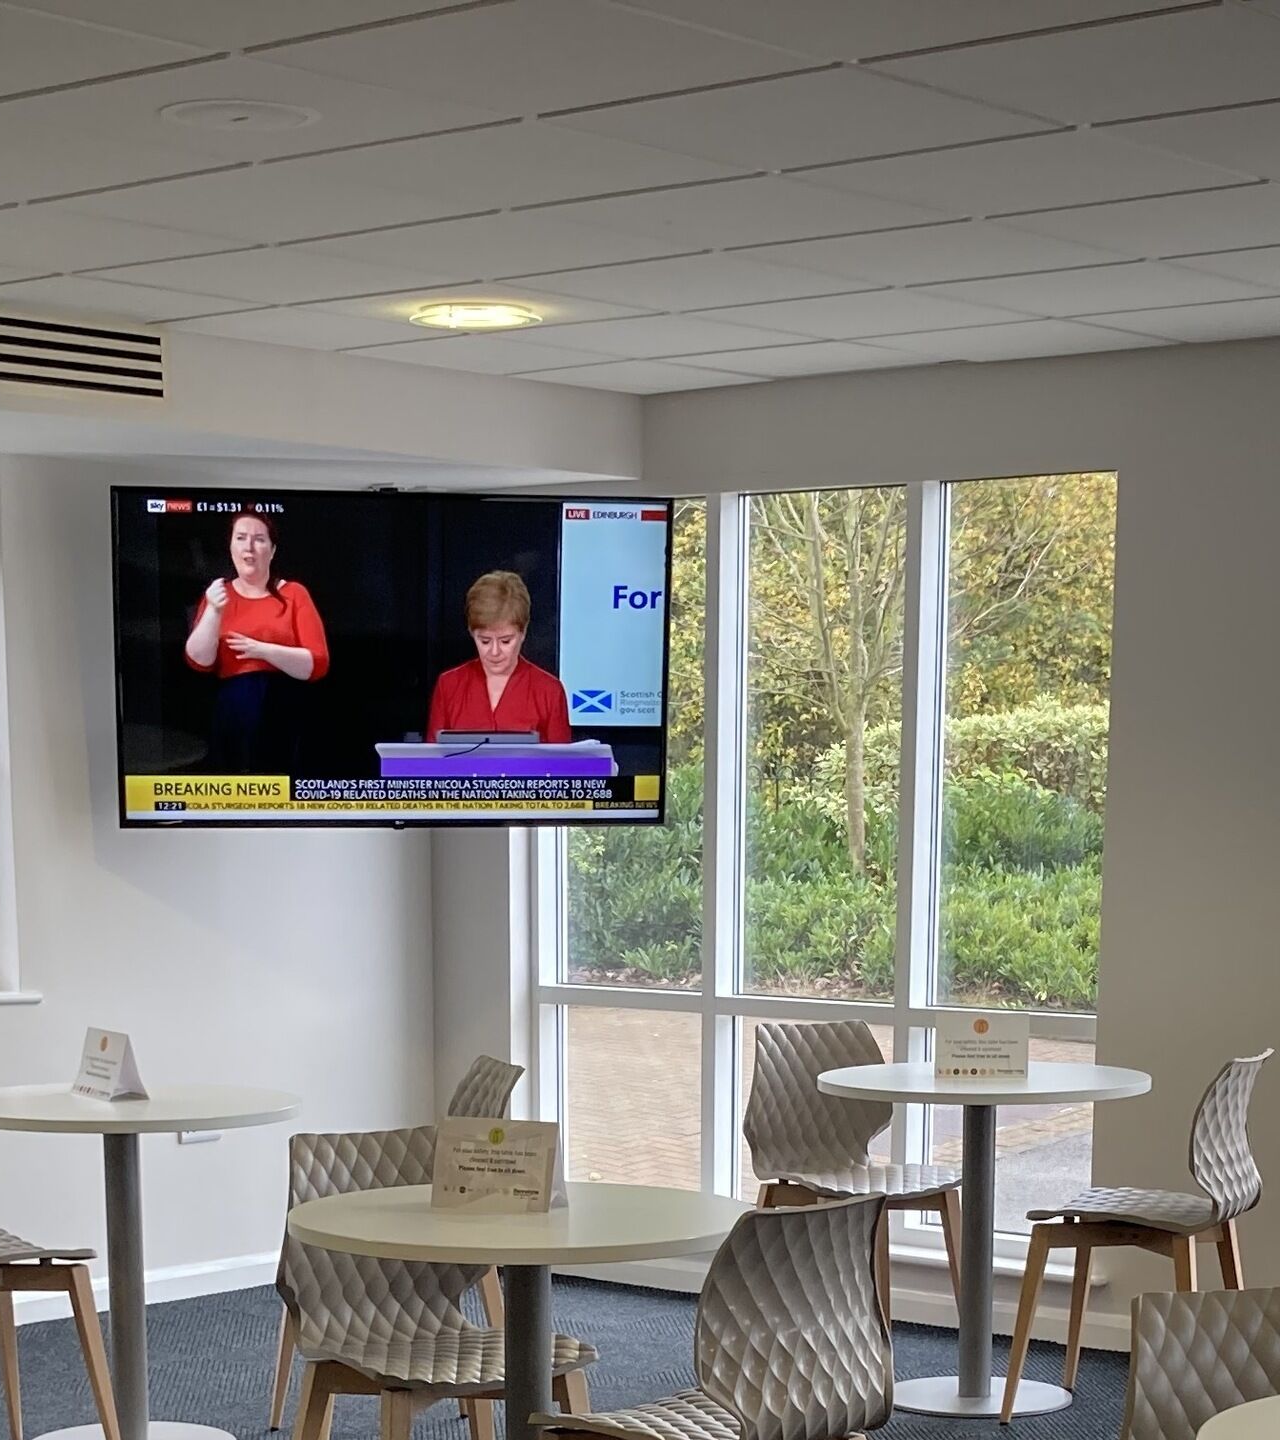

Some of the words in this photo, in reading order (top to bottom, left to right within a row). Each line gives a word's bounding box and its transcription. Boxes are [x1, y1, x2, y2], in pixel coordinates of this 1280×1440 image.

[150, 501, 164, 510] sky
[167, 502, 191, 510] news
[568, 509, 586, 519] LIVE
[592, 510, 637, 519] EDINBURGH
[613, 585, 662, 609] For
[295, 780, 357, 789] SCOTLAND'S
[359, 780, 385, 789] FIRST
[387, 780, 432, 789] MINISTER
[434, 780, 471, 789] NICOLA
[472, 780, 524, 789] STURGEON
[527, 780, 569, 789] REPORTS
[571, 780, 581, 788] 18
[584, 780, 606, 788] NEW
[154, 783, 232, 796] BREAKING
[236, 783, 281, 796] NEWS
[295, 790, 341, 799] COVID-19
[343, 790, 386, 799] RELATED
[388, 790, 427, 799] DEATHS
[428, 790, 439, 799] IN
[441, 790, 460, 799] THE
[462, 790, 499, 799] NATION
[501, 790, 536, 799] TAKING
[538, 790, 569, 799] TOTAL
[571, 790, 584, 799] TO
[586, 790, 612, 799] 2,688
[211, 802, 255, 810] STURGEON
[257, 802, 295, 810] REPORTS
[307, 802, 325, 810] NEW
[327, 802, 364, 810] COVID-19
[366, 802, 400, 810] RELATED
[402, 802, 433, 810] DEATHS
[445, 802, 460, 810] THE
[462, 802, 493, 810] NATION
[495, 802, 523, 810] TAKING
[526, 802, 550, 810] TOTAL
[595, 801, 634, 809] BREAKING
[635, 801, 658, 809] NEWS
